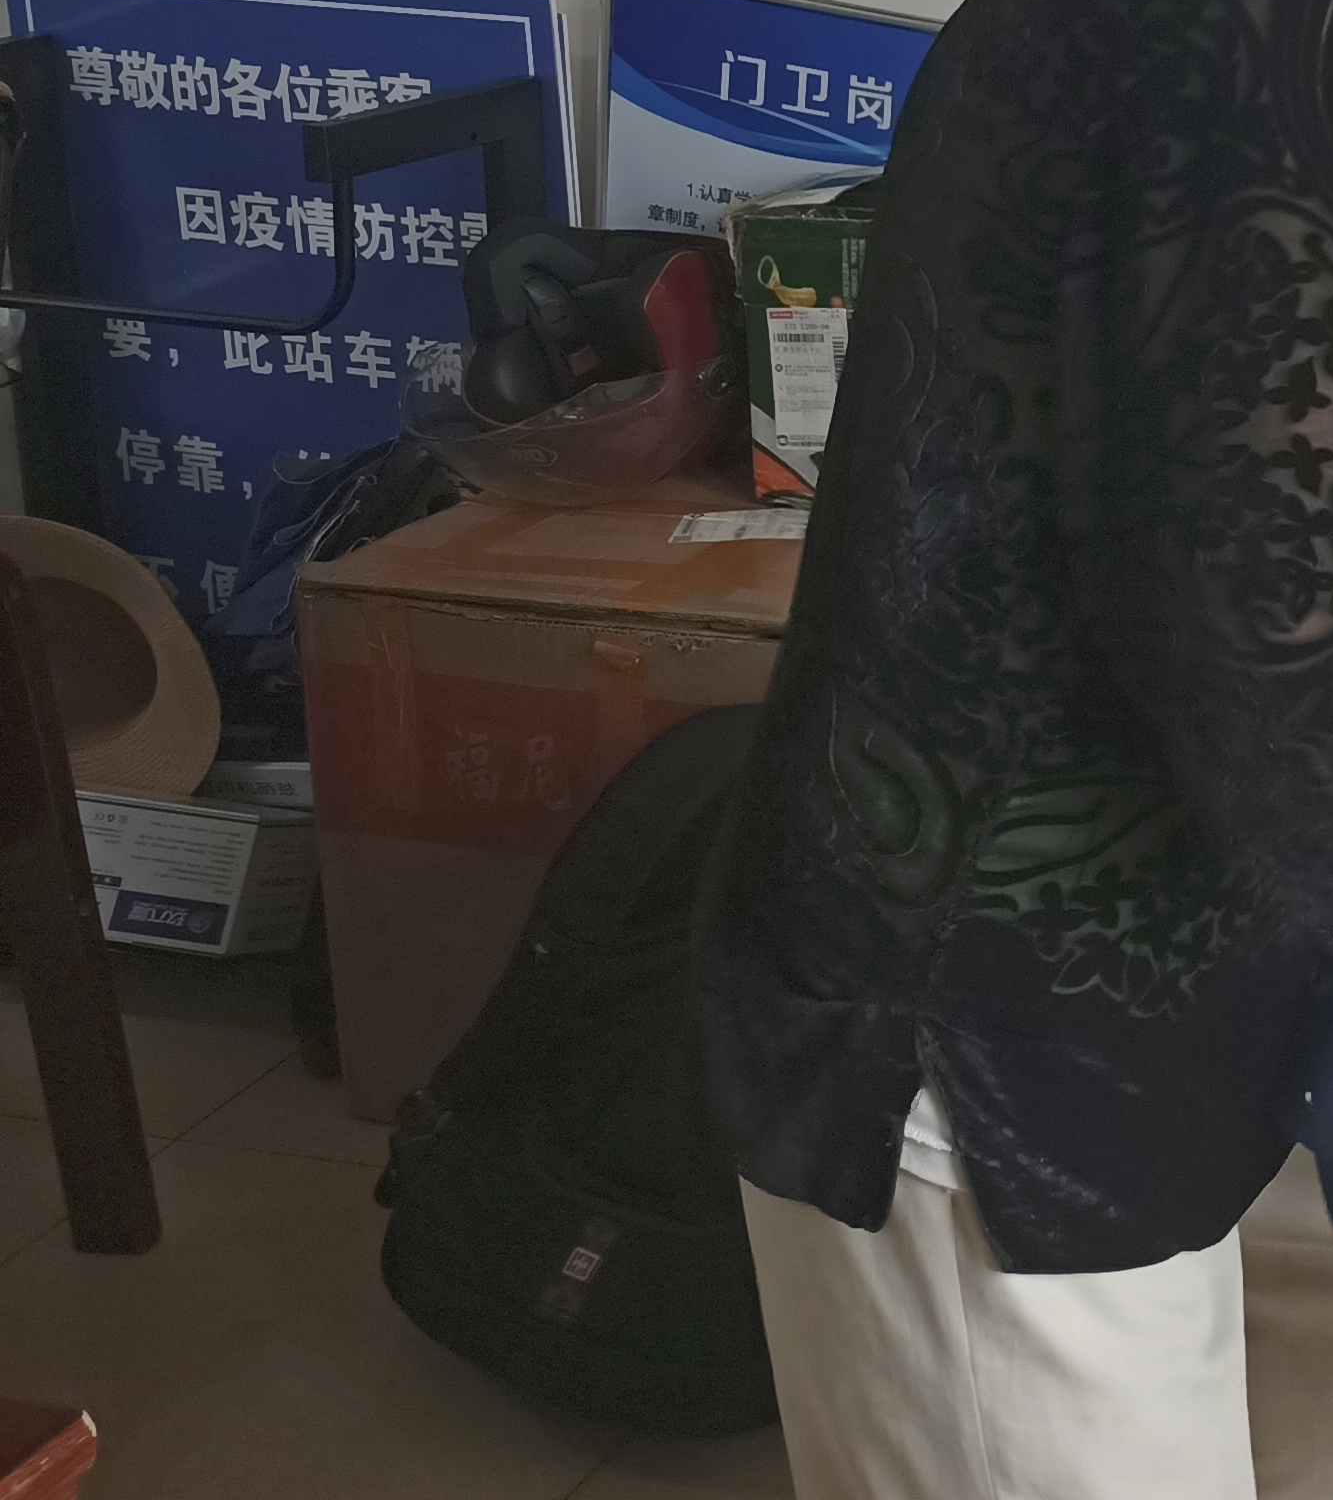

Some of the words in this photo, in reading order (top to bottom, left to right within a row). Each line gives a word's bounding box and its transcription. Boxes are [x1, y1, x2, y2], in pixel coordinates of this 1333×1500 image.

[719, 50, 893, 131] 门卫岗
[115, 426, 331, 500] 停靠，
